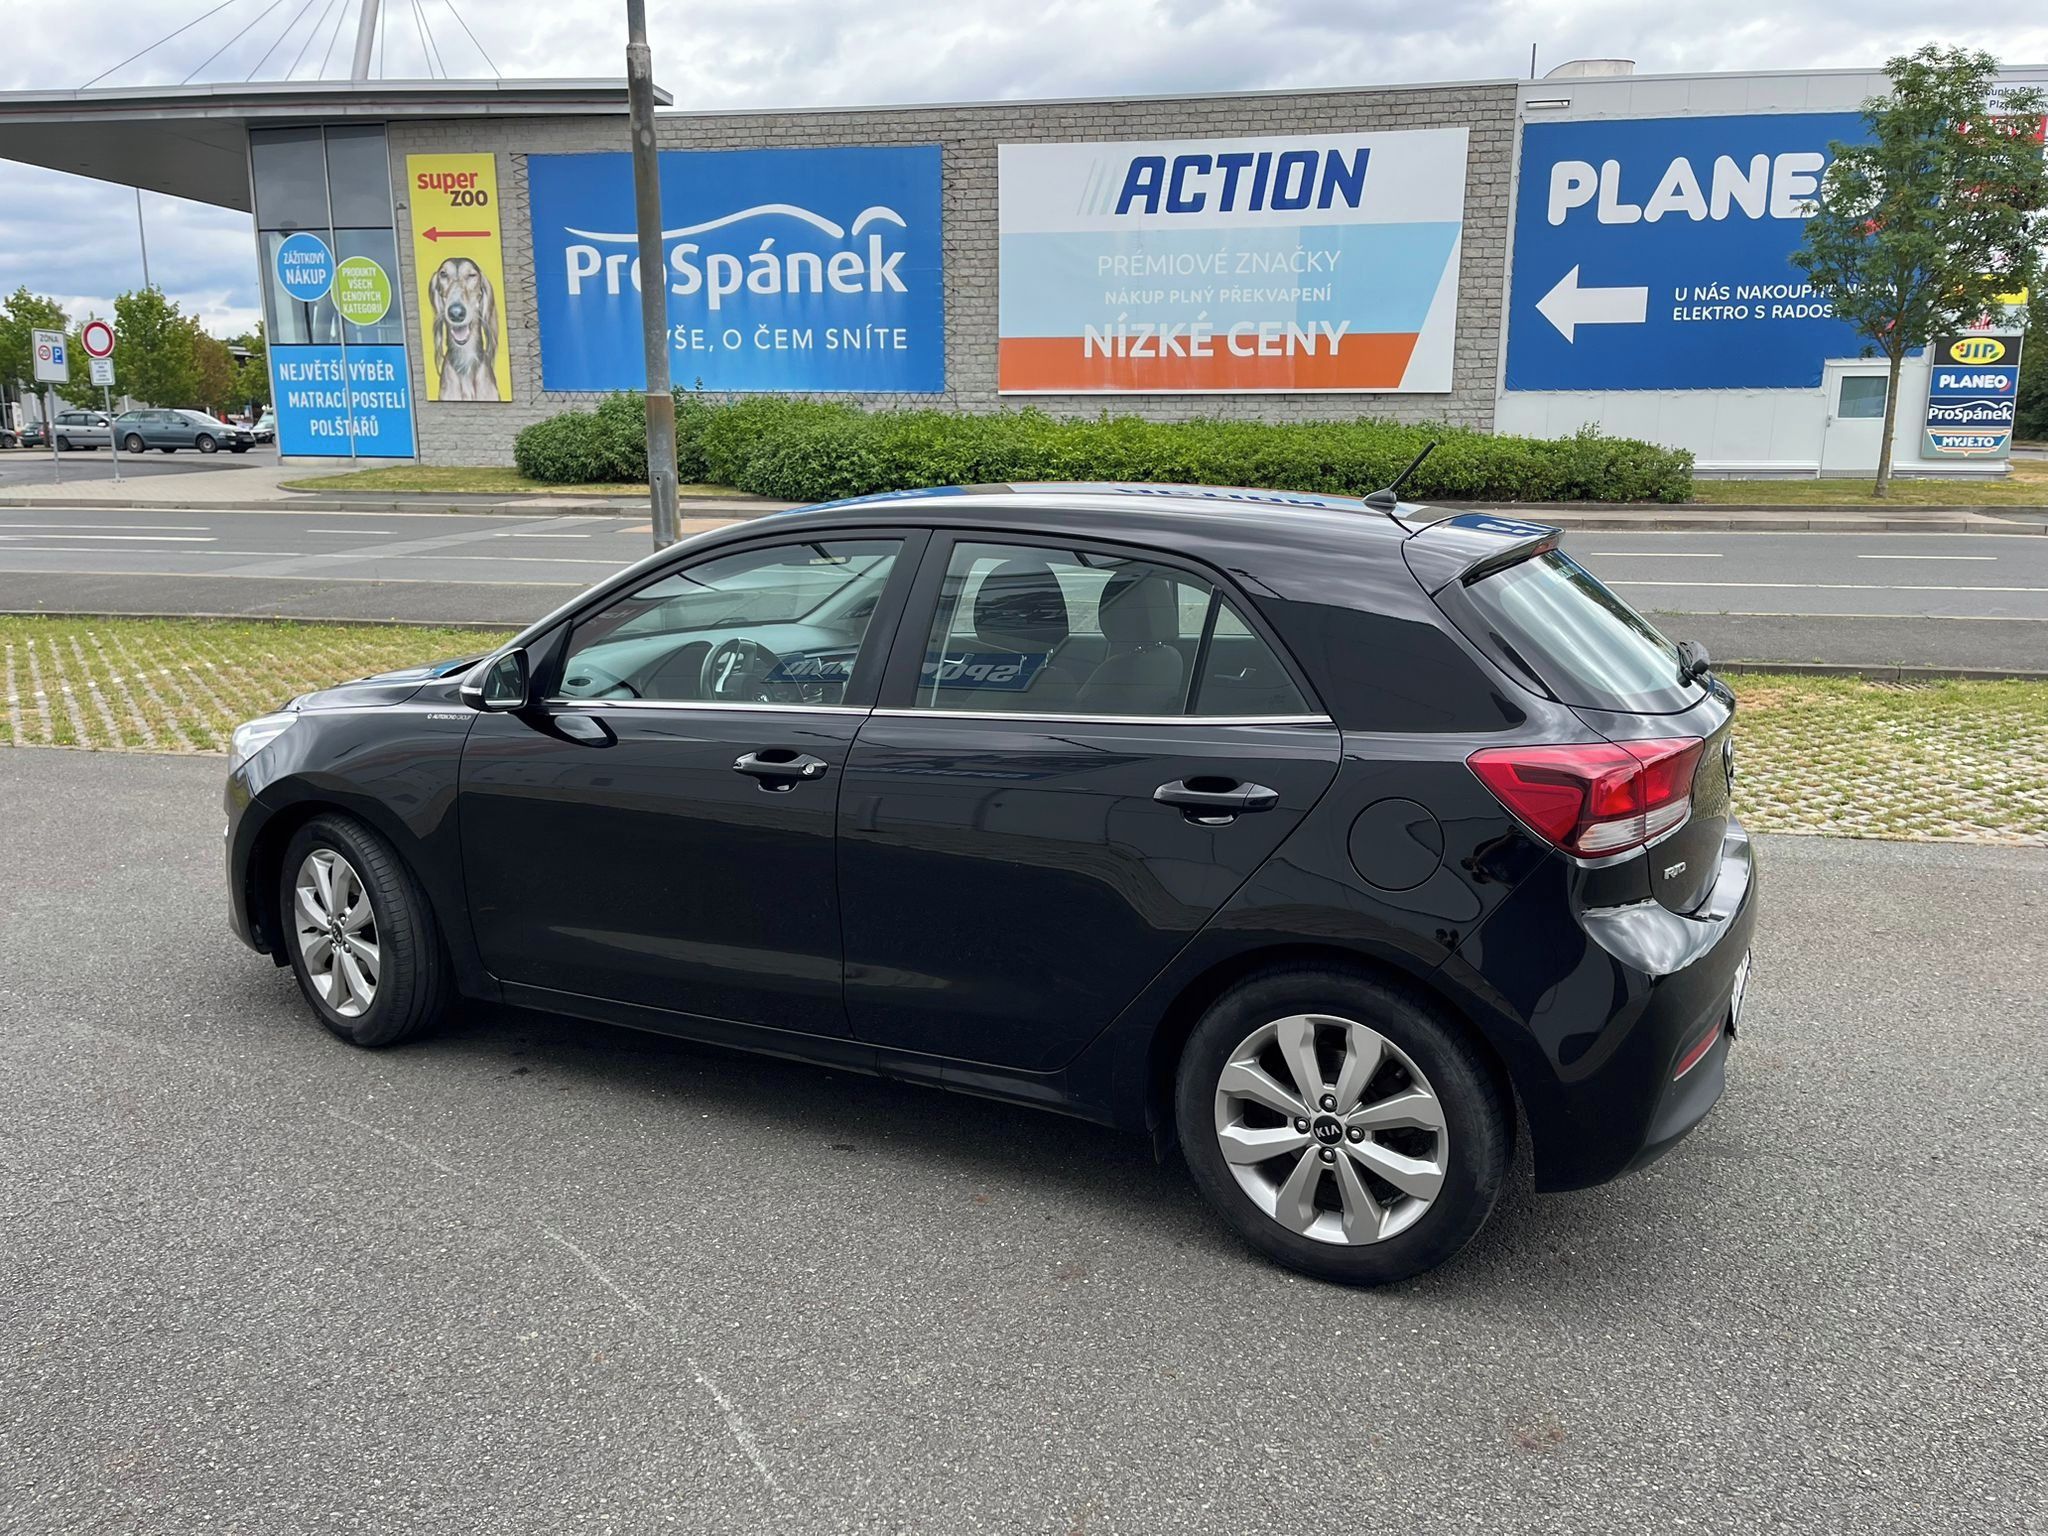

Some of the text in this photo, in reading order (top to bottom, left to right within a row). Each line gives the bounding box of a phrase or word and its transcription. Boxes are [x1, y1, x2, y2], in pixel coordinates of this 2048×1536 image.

[417, 170, 478, 193] super
[1115, 148, 1371, 214] ACTION
[450, 190, 488, 207] zoo
[283, 250, 325, 264] ZÁŽITKOVÝ
[1097, 246, 1341, 276] PRÉMIOVÉ ZNAČKY
[286, 266, 326, 284] NÁKUP
[342, 267, 376, 276] PRODUKTY
[1105, 283, 1332, 305] NÁKUP PLNÝ PŘEKVAPENÍ
[1675, 287, 1688, 301] U
[1694, 282, 1730, 300] NÁS
[1673, 304, 1749, 321] ELEKTRO
[1754, 304, 1765, 319] S
[722, 328, 742, 350] O
[754, 323, 813, 350] ČEM
[826, 324, 908, 350] SNÍTE
[1084, 311, 1351, 358] NÍZKÉ CENY
[1960, 344, 1996, 358] JIP
[280, 360, 395, 381] NEJVĚTŠÍ VÝBĚR
[1939, 374, 2008, 389] PLANEO
[289, 388, 406, 409] MATRACÍ POSTELÍ
[1928, 407, 2013, 424] ProSpánek
[310, 415, 380, 437] POLŠTÁŘŮ
[1942, 437, 1995, 447] MYJE.TO
[1663, 861, 1687, 880] RIO
[1315, 1124, 1341, 1138] KIA
